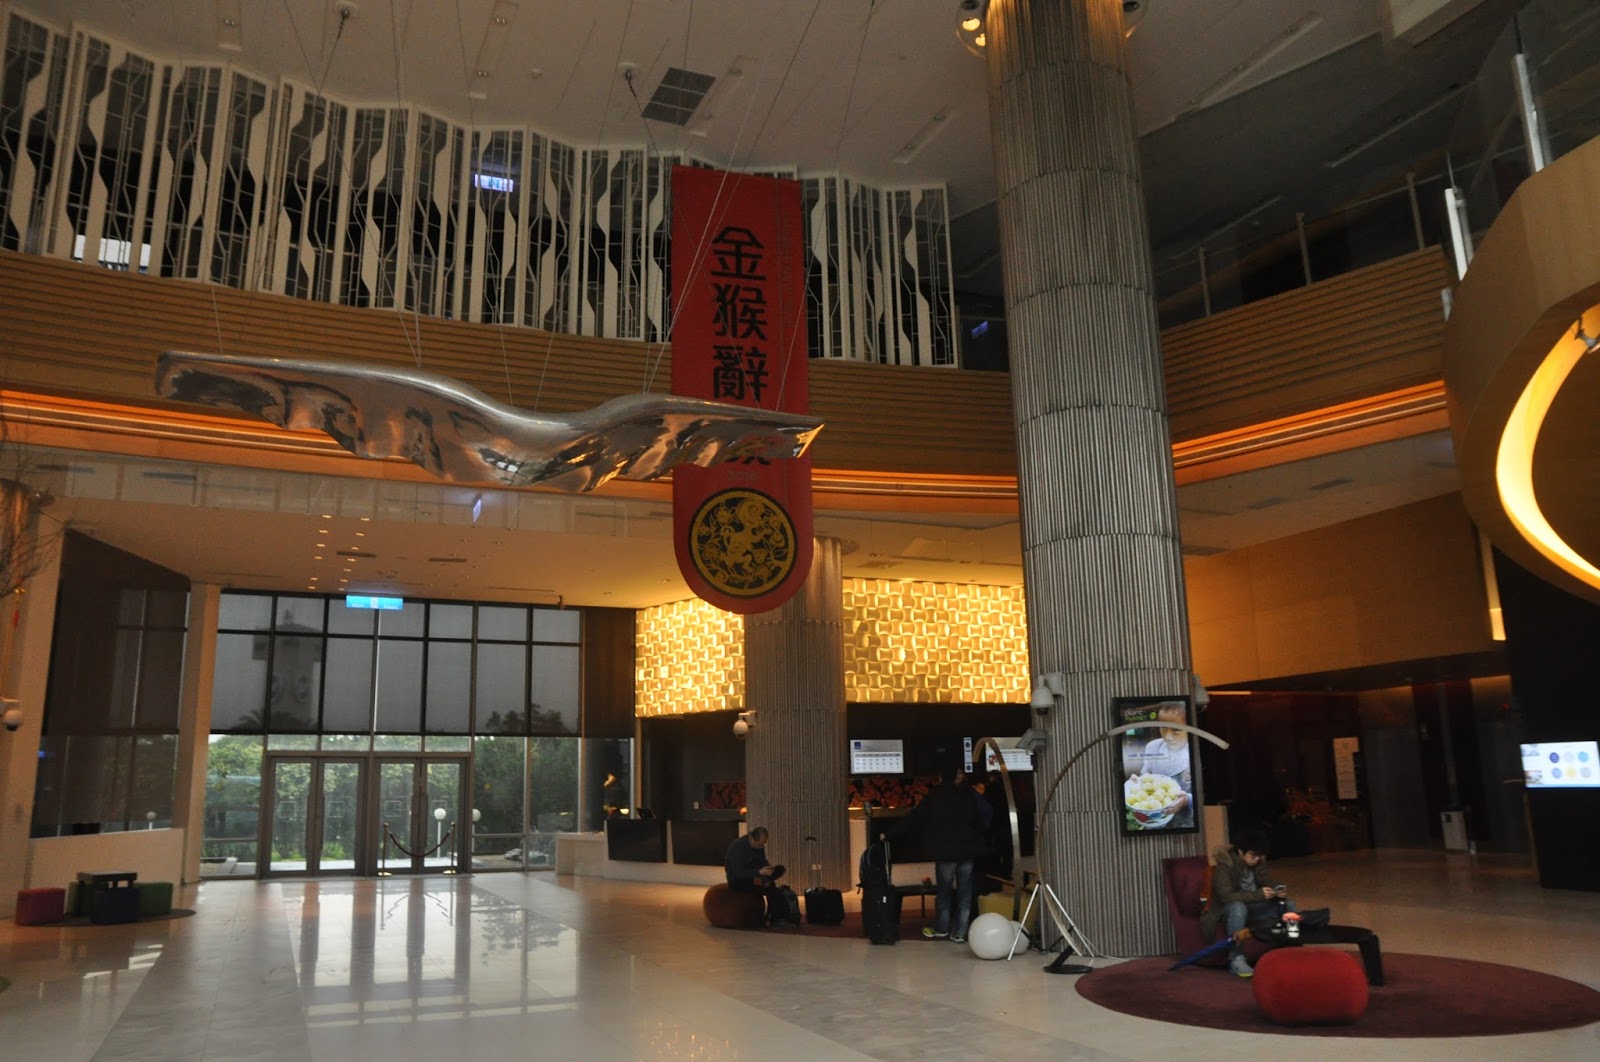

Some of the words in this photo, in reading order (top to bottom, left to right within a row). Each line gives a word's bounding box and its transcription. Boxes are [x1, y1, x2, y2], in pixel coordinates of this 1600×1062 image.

[711, 226, 771, 465] 金猴辭
[726, 469, 758, 481] 2016
